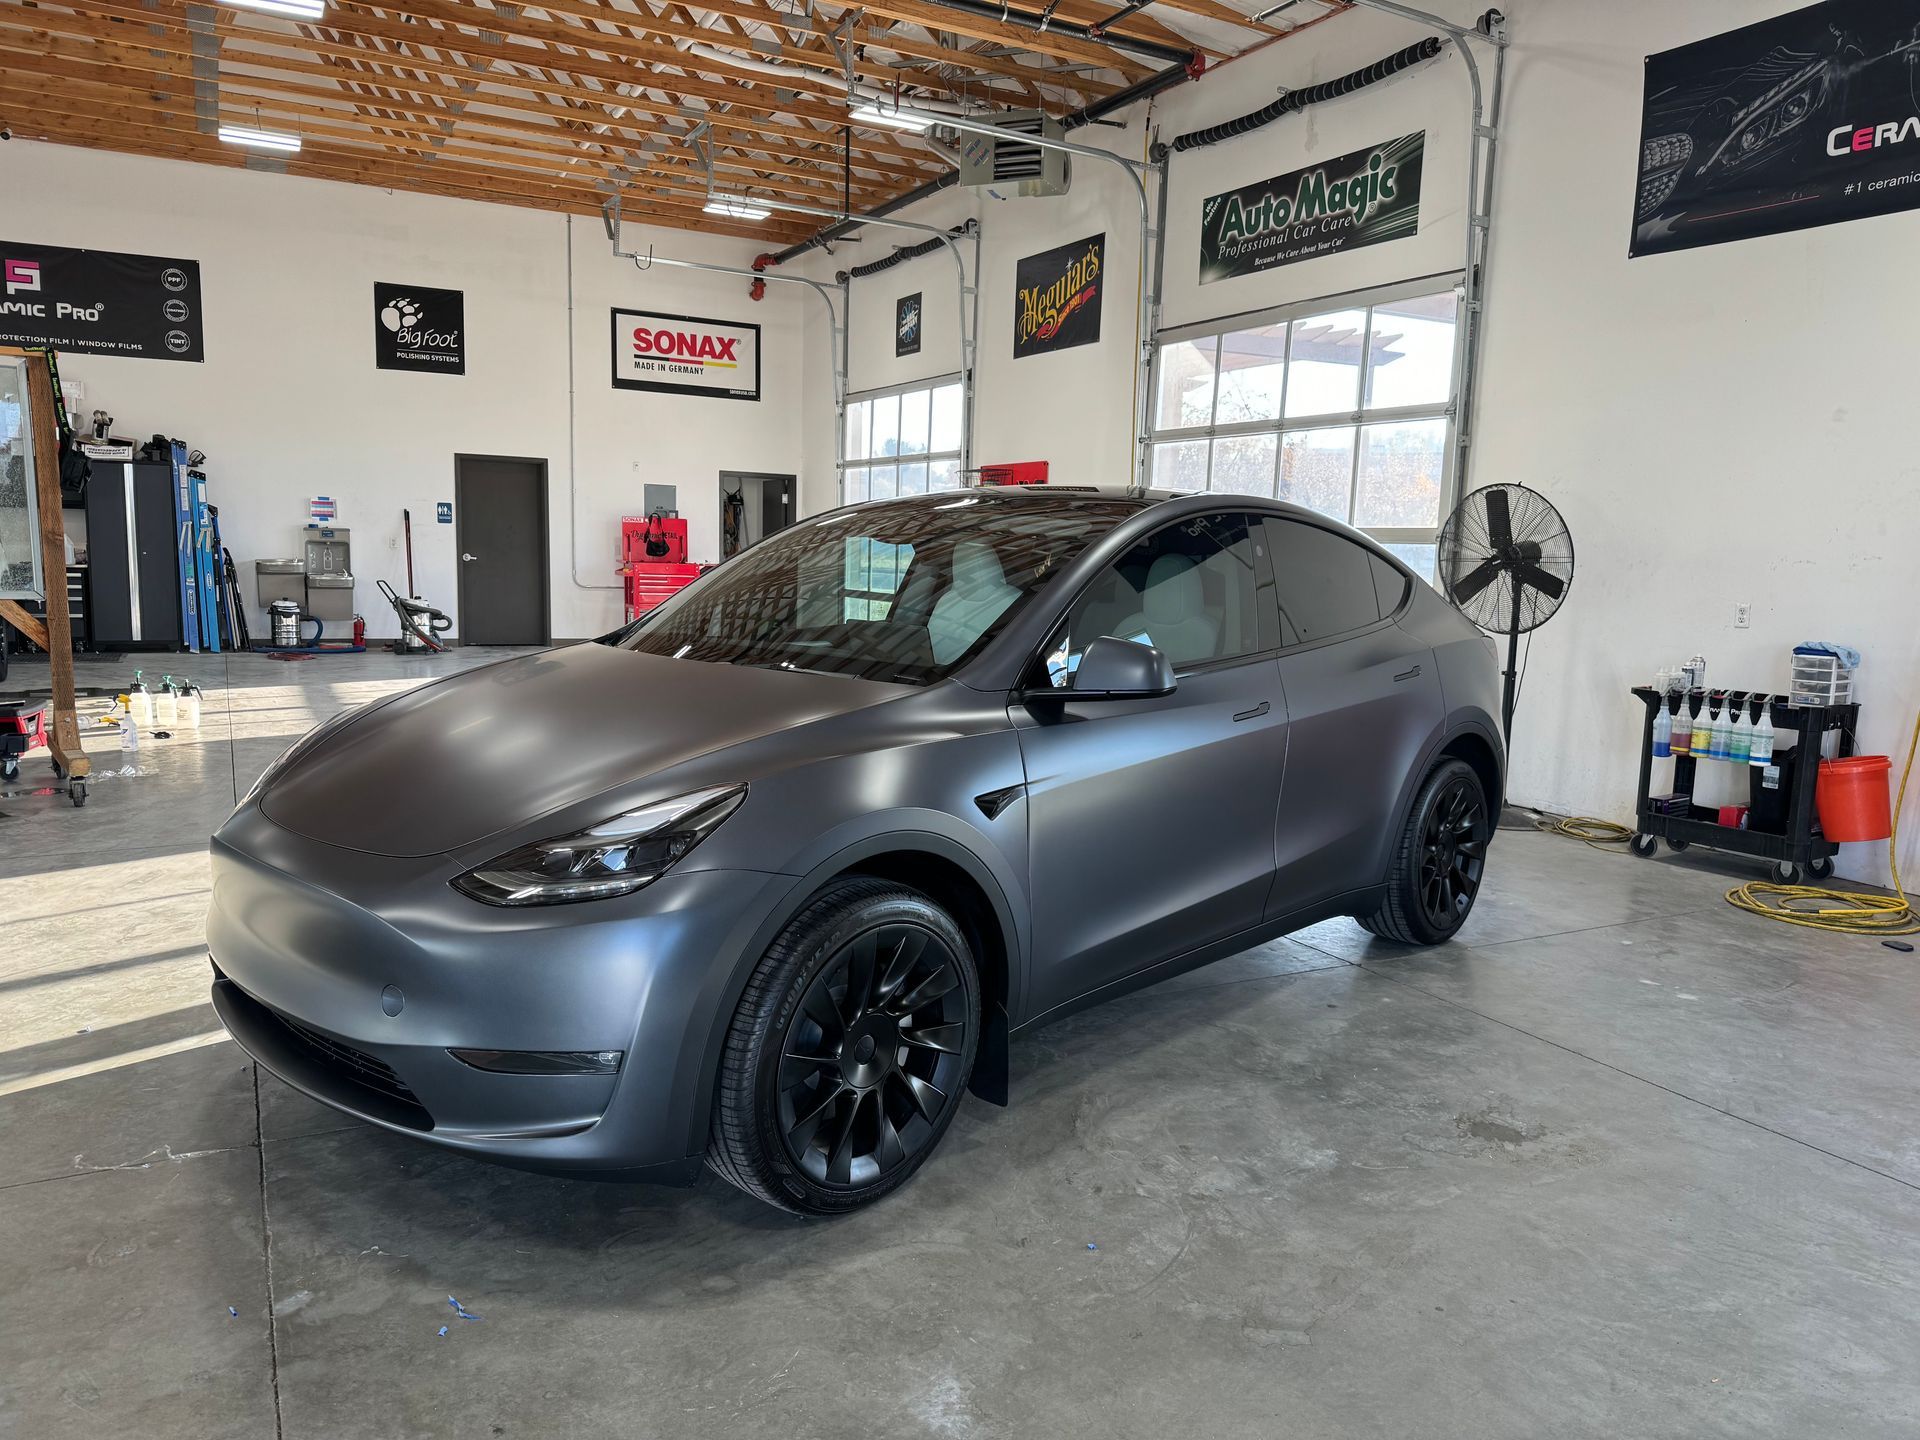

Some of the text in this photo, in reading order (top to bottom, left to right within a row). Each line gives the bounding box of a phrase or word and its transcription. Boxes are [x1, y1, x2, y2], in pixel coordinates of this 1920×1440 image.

[1843, 171, 1920, 196] #1 ceramic
[1218, 215, 1351, 260] Professional Car Care
[1254, 238, 1344, 266] Because We Care About Your Car
[1017, 244, 1099, 344] Meguiar's
[49, 337, 70, 345] FILM
[77, 340, 116, 348] WINDOW
[118, 342, 143, 351] FILMS
[632, 327, 738, 361] SONAX
[396, 352, 460, 363] POLISHING SYSTEMS
[634, 361, 705, 375] MADE IN GERMANY
